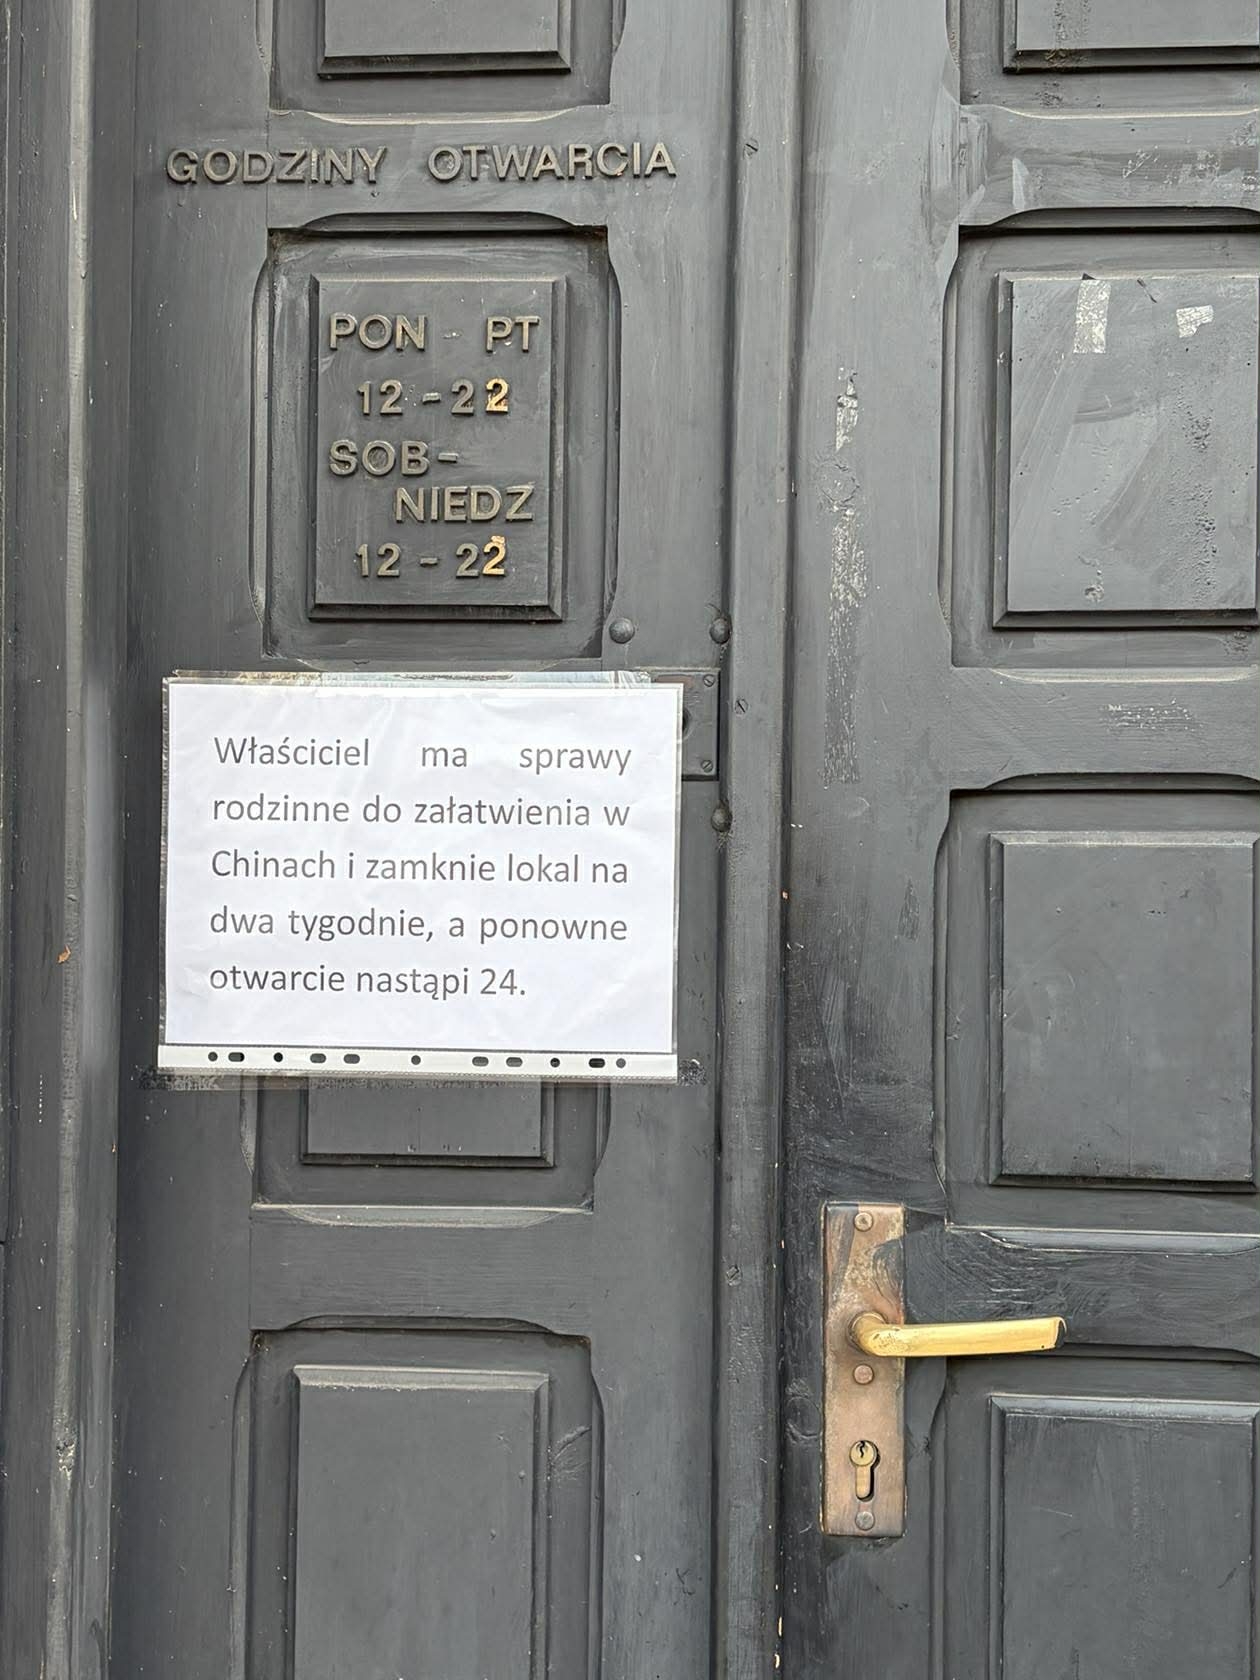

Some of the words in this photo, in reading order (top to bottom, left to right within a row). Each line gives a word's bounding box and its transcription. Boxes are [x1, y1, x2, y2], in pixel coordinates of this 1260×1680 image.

[167, 147, 388, 184] GODZINY
[428, 143, 677, 180] OTWARCIA
[329, 313, 427, 350] PON
[486, 316, 540, 351] PT
[395, 483, 535, 522] NIEDZ
[214, 737, 368, 765] Właściciel
[422, 748, 466, 767] ma
[520, 749, 631, 775] sprawy
[214, 793, 349, 821] rodzinne
[363, 795, 401, 822] do
[415, 796, 589, 825] załatwienia
[604, 807, 629, 825] w
[212, 849, 334, 878] Chinach
[349, 853, 353, 878] i
[366, 853, 495, 881] zamknie
[509, 854, 578, 882] lokal
[593, 863, 627, 883] na
[211, 905, 273, 933] dwa
[288, 908, 432, 942] tygodnie,
[449, 918, 464, 937] a
[481, 919, 627, 944] ponowne
[210, 965, 344, 991] otwarcie
[358, 968, 468, 1000] nastąpi
[481, 969, 525, 995] 24.
